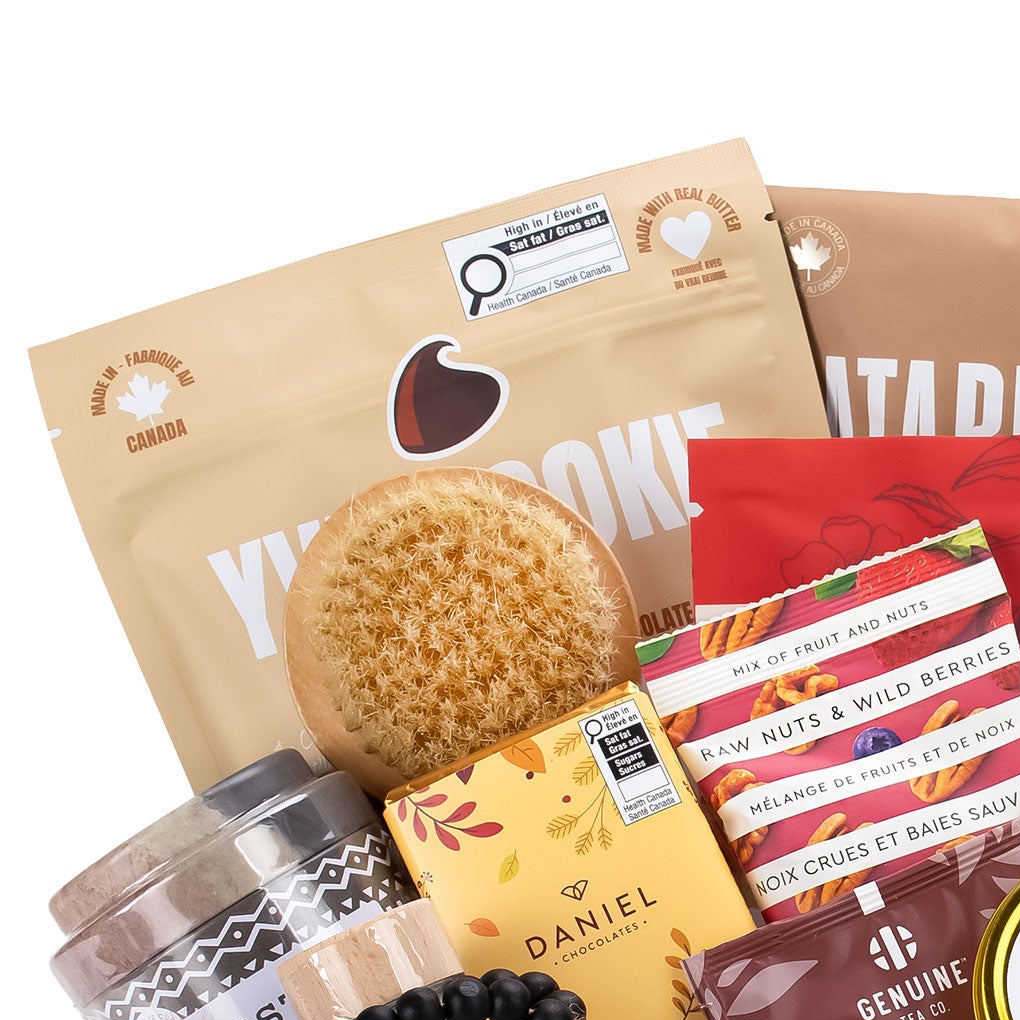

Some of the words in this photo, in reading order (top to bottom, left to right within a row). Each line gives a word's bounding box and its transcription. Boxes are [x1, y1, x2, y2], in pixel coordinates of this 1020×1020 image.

[642, 191, 674, 217] WITH
[674, 187, 704, 202] REAL
[504, 223, 531, 237] High
[532, 218, 543, 228] in
[553, 204, 583, 222] Élevé
[585, 201, 599, 211] en
[706, 193, 742, 233] BUTTER
[509, 238, 530, 252] Sat
[531, 232, 548, 245] fat
[556, 222, 583, 237] Gras
[584, 214, 606, 228] sat.
[636, 216, 653, 254] MADE
[799, 218, 810, 227] IN
[813, 219, 846, 252] CANADA
[487, 297, 515, 312] Health
[516, 285, 548, 303] Canada
[554, 273, 579, 289] Santé
[580, 263, 612, 280] Canada
[91, 380, 107, 417] MADE
[102, 365, 118, 381] IN
[124, 350, 183, 374] FABRIQUE
[175, 369, 195, 387] AU
[125, 418, 188, 454] CANADA
[639, 601, 693, 636] OLATE
[733, 659, 761, 677] MIX
[767, 650, 789, 667] OF
[795, 633, 841, 657] FRUIT
[848, 618, 880, 638] AND
[886, 600, 929, 625] NUTS
[602, 710, 620, 723] High
[621, 706, 630, 716] in
[629, 713, 638, 722] en
[700, 735, 750, 762] RAW
[761, 713, 821, 745] NUTS
[831, 706, 845, 721] &
[853, 682, 911, 712] WILD
[921, 641, 1012, 688] BERRIES
[604, 735, 620, 746] Sat
[620, 729, 632, 740] fat
[608, 742, 628, 755] Gras
[628, 735, 644, 747] sat.
[614, 751, 643, 768] Sugars
[618, 760, 647, 776] Sucres
[749, 782, 828, 816] MÉLANGE
[836, 774, 856, 789] DE
[861, 756, 918, 783] FRUITS
[923, 748, 943, 764] ET
[948, 736, 970, 755] DE
[975, 718, 1016, 743] NOIX
[623, 798, 646, 813] Health
[646, 787, 672, 803] Canada
[628, 807, 649, 821] Santé
[649, 796, 675, 812] Canada
[755, 867, 799, 897] NOIX
[803, 842, 870, 876] CRUES
[875, 831, 899, 852] ET
[906, 812, 963, 842] BAIES
[524, 887, 658, 960] DANIEL
[562, 922, 640, 963] CHOCOLATES
[930, 1001, 951, 1018] CO.
